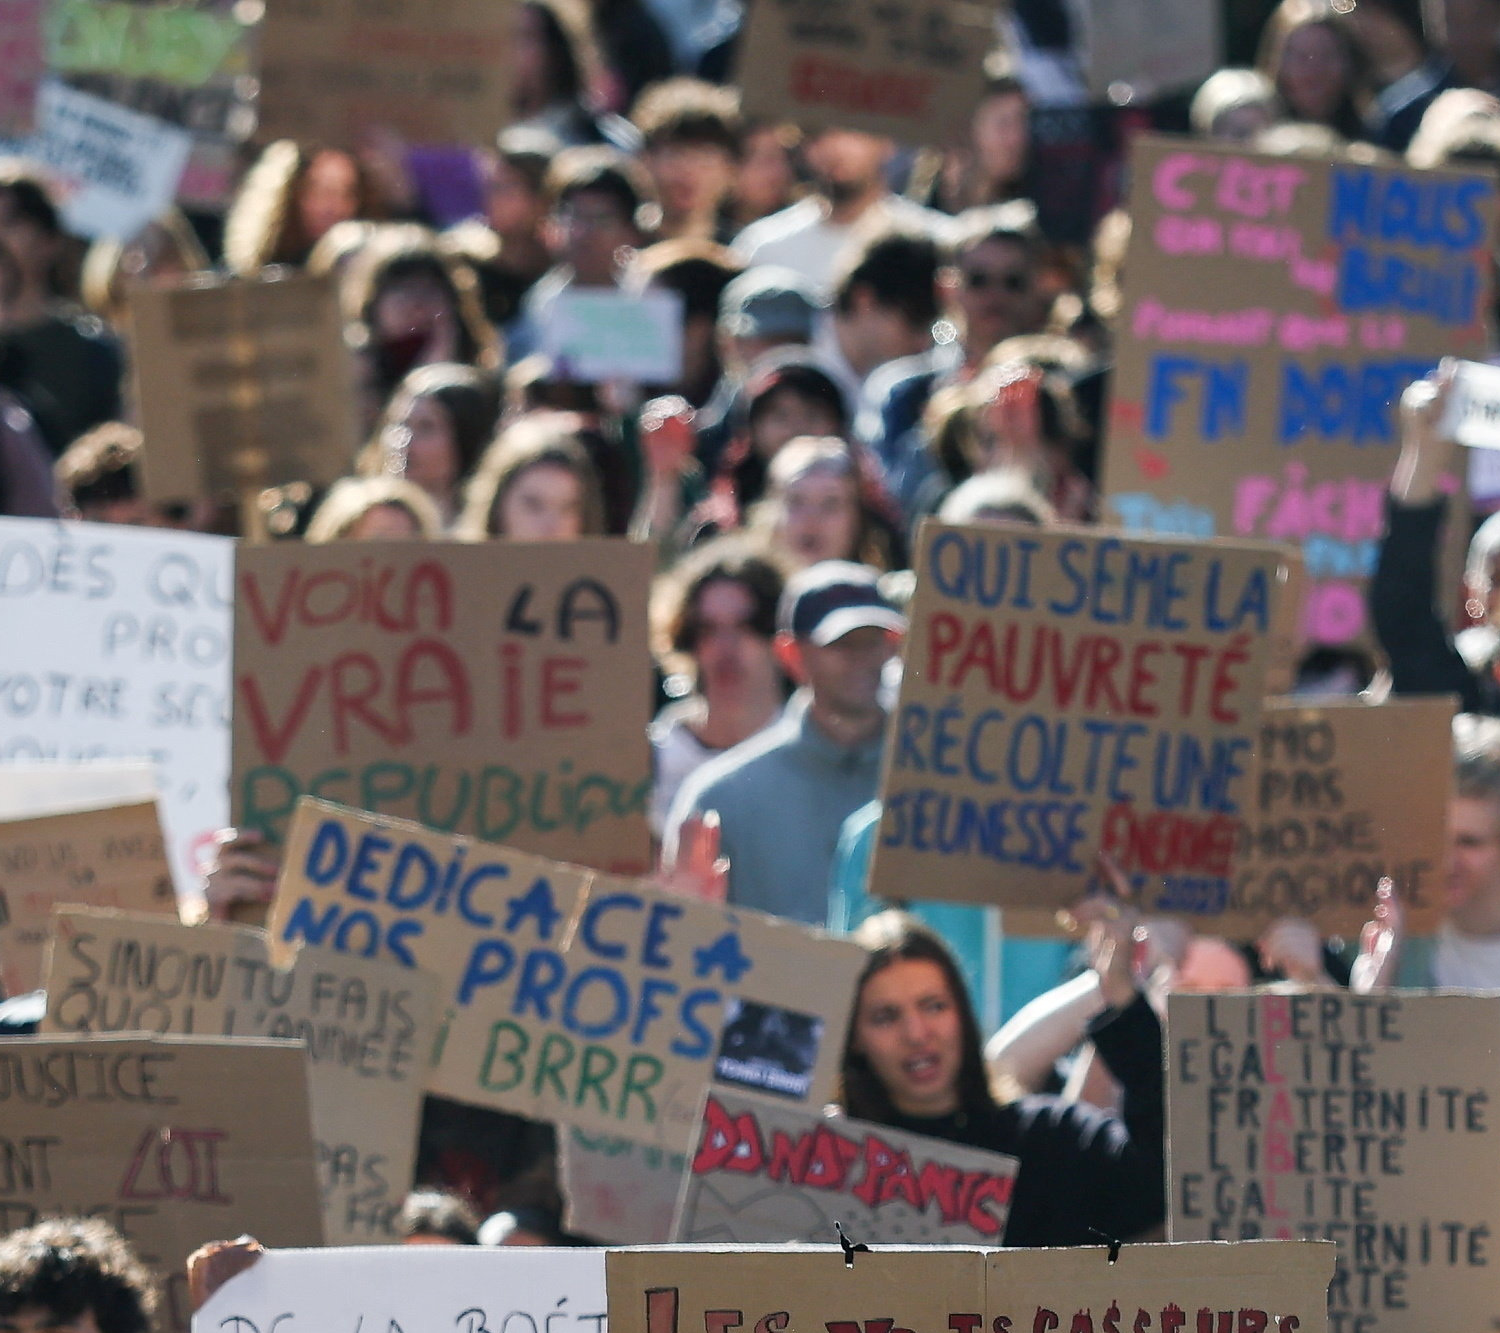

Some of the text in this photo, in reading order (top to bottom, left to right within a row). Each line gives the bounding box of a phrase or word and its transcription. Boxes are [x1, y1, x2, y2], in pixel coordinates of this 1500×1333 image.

[505, 576, 620, 643] LA
[928, 530, 1272, 636] QUI LA
[927, 612, 1251, 725] PAUVRETÉ
[897, 693, 1252, 816] RÉCOLTE UNE
[232, 953, 299, 999] TU
[456, 936, 726, 1061] PROFS
[477, 1019, 666, 1124] BRRR
[119, 1127, 235, 1205] LOI
[691, 1096, 764, 1177] DO
[853, 1131, 1016, 1236] PANIC
